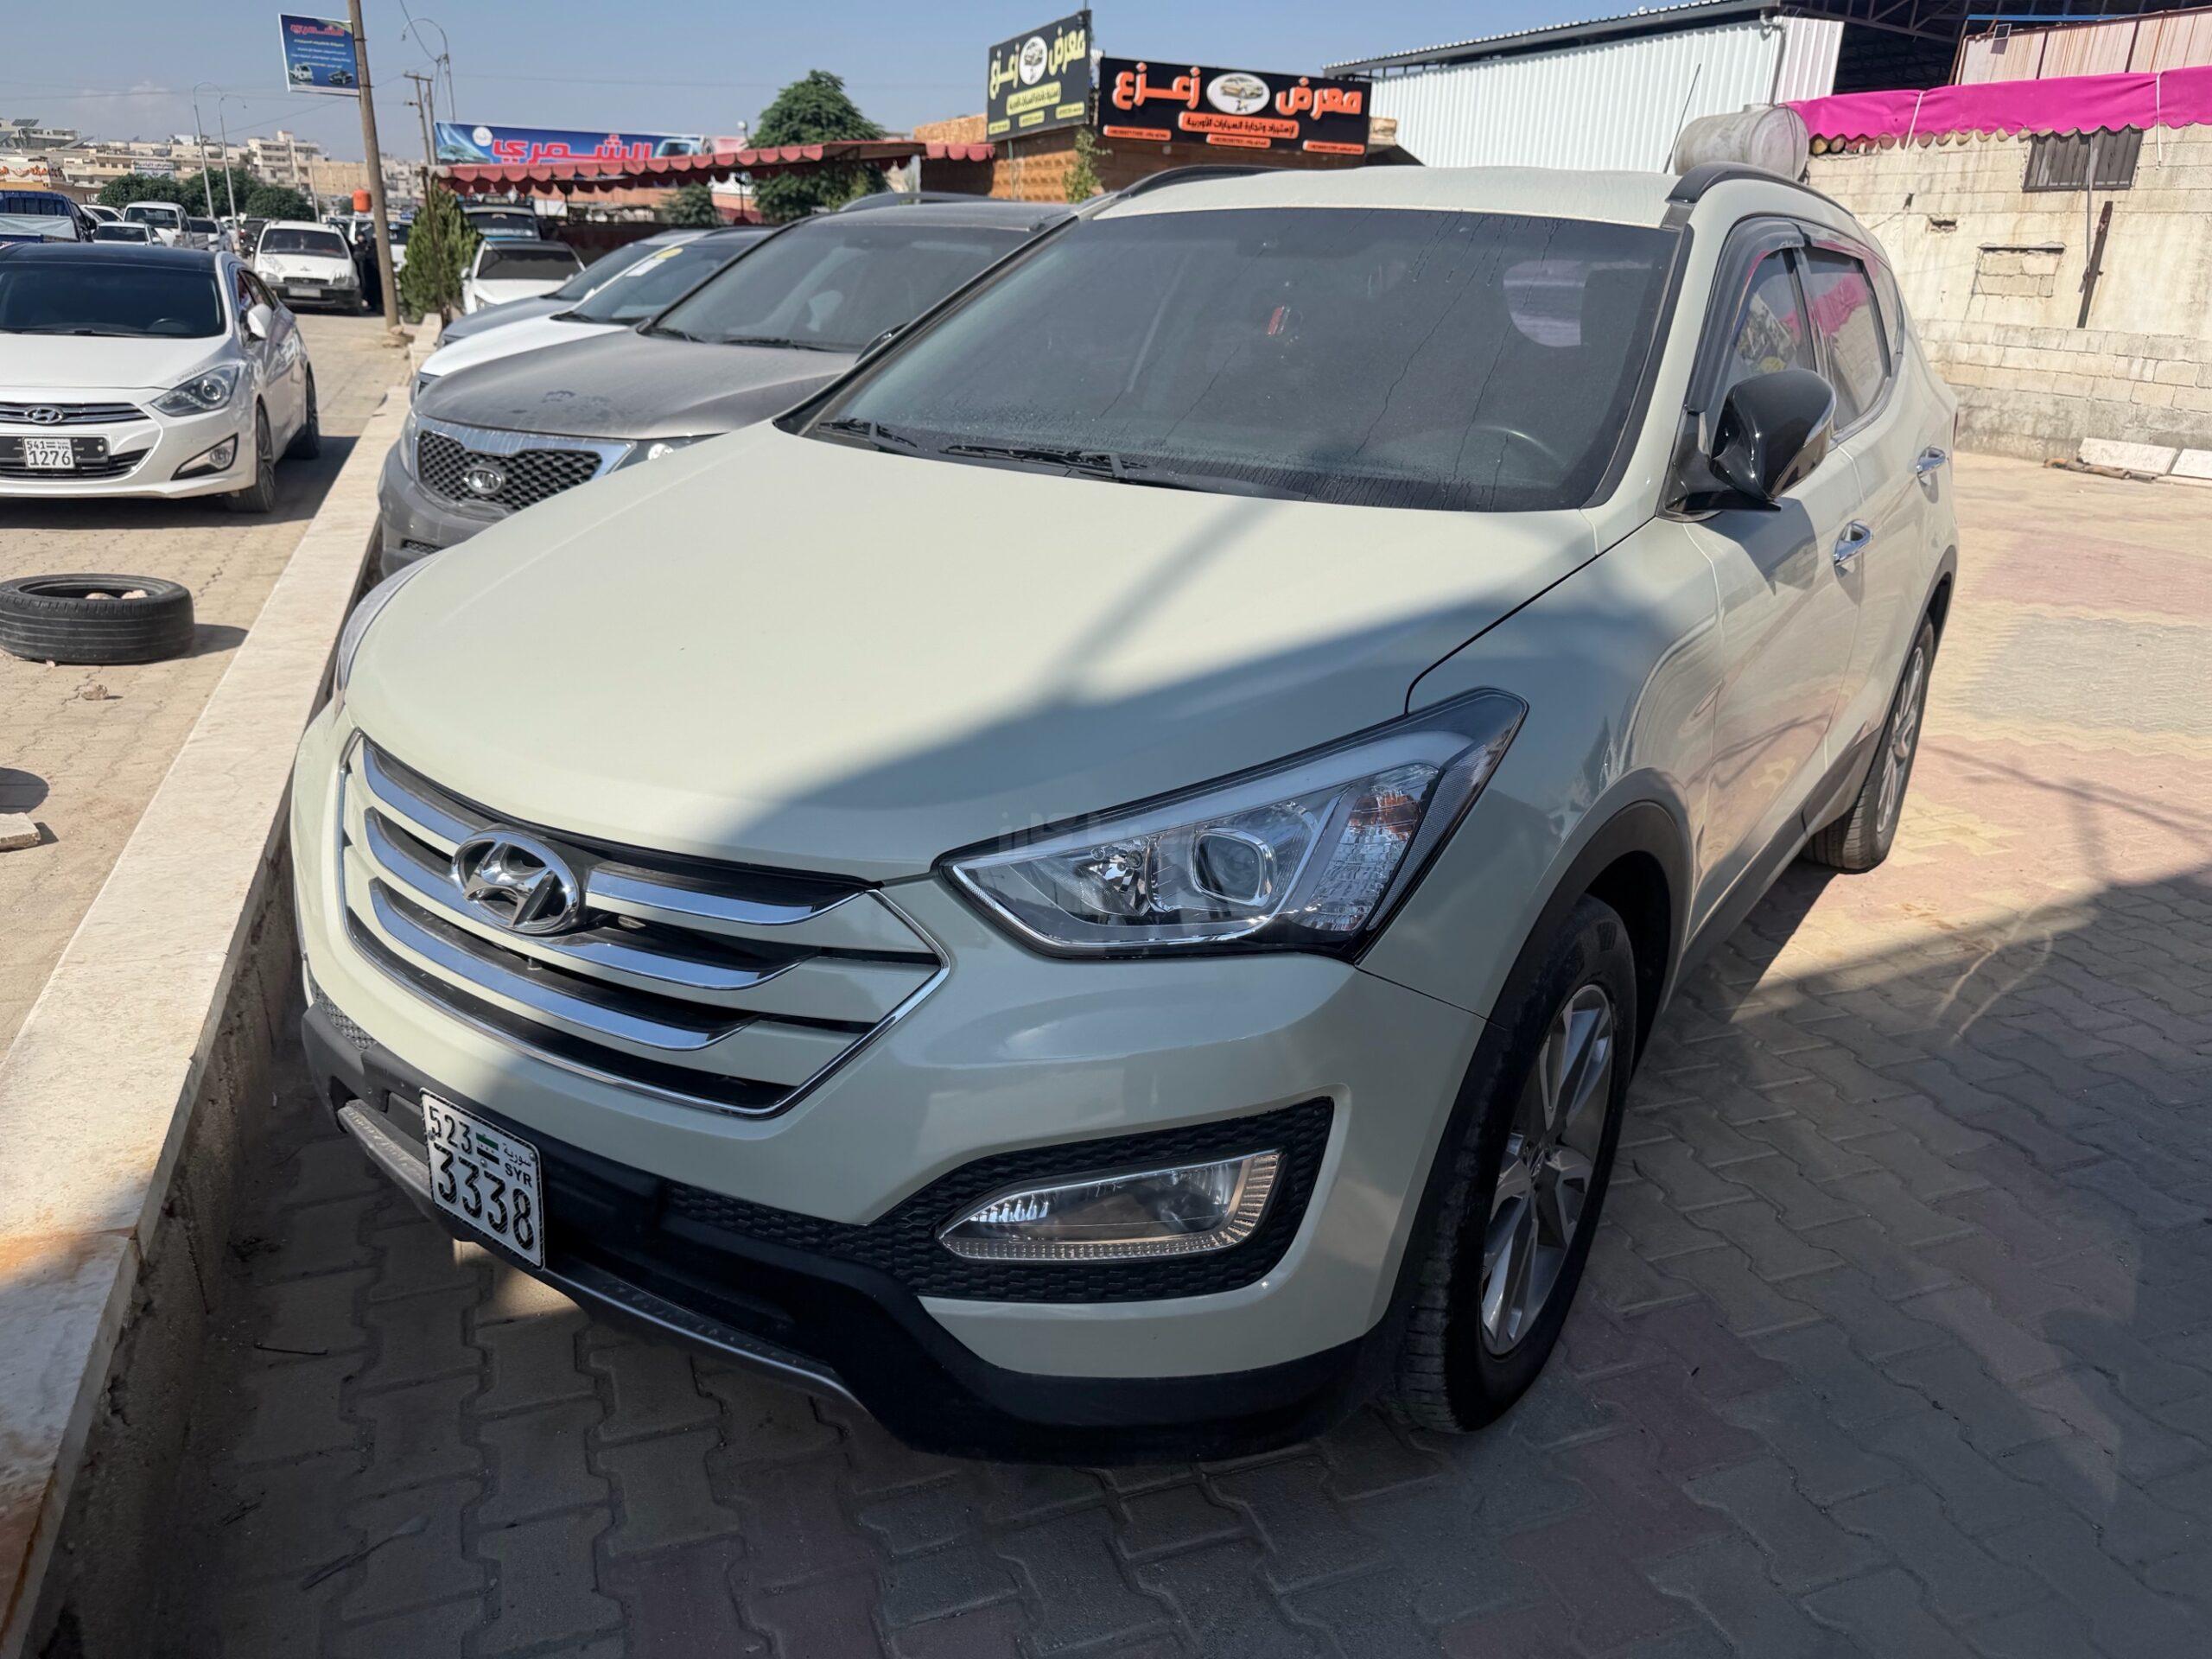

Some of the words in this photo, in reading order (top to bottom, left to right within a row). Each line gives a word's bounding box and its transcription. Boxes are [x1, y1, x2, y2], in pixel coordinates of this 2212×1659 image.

[1048, 25, 1086, 76] معرض
[1275, 76, 1363, 120] معرض
[29, 450, 71, 466] 1276
[428, 1105, 473, 1155] 523
[433, 1141, 535, 1251] 3338
[505, 1162, 533, 1188] SYR
